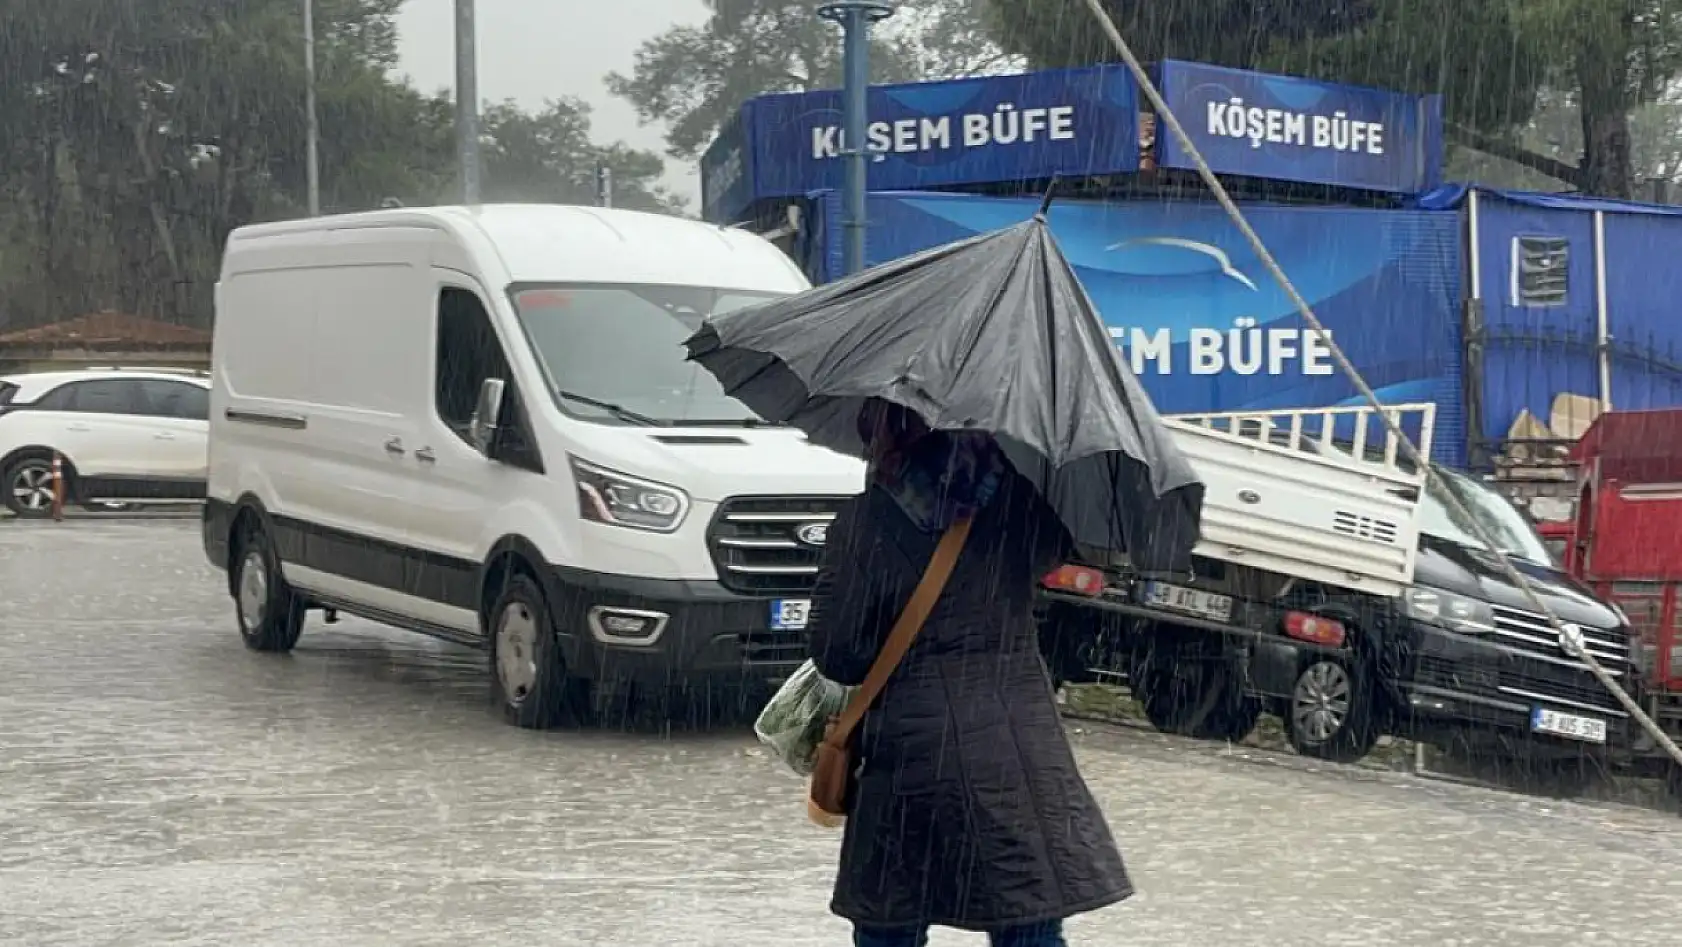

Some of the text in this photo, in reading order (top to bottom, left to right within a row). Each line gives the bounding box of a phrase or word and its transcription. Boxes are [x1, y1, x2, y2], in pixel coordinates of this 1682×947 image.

[963, 102, 1074, 146] BÜFE
[1207, 97, 1384, 154] KÖŞEM BÜFE
[1189, 316, 1334, 375] BÜFE
[782, 602, 804, 621] 35
